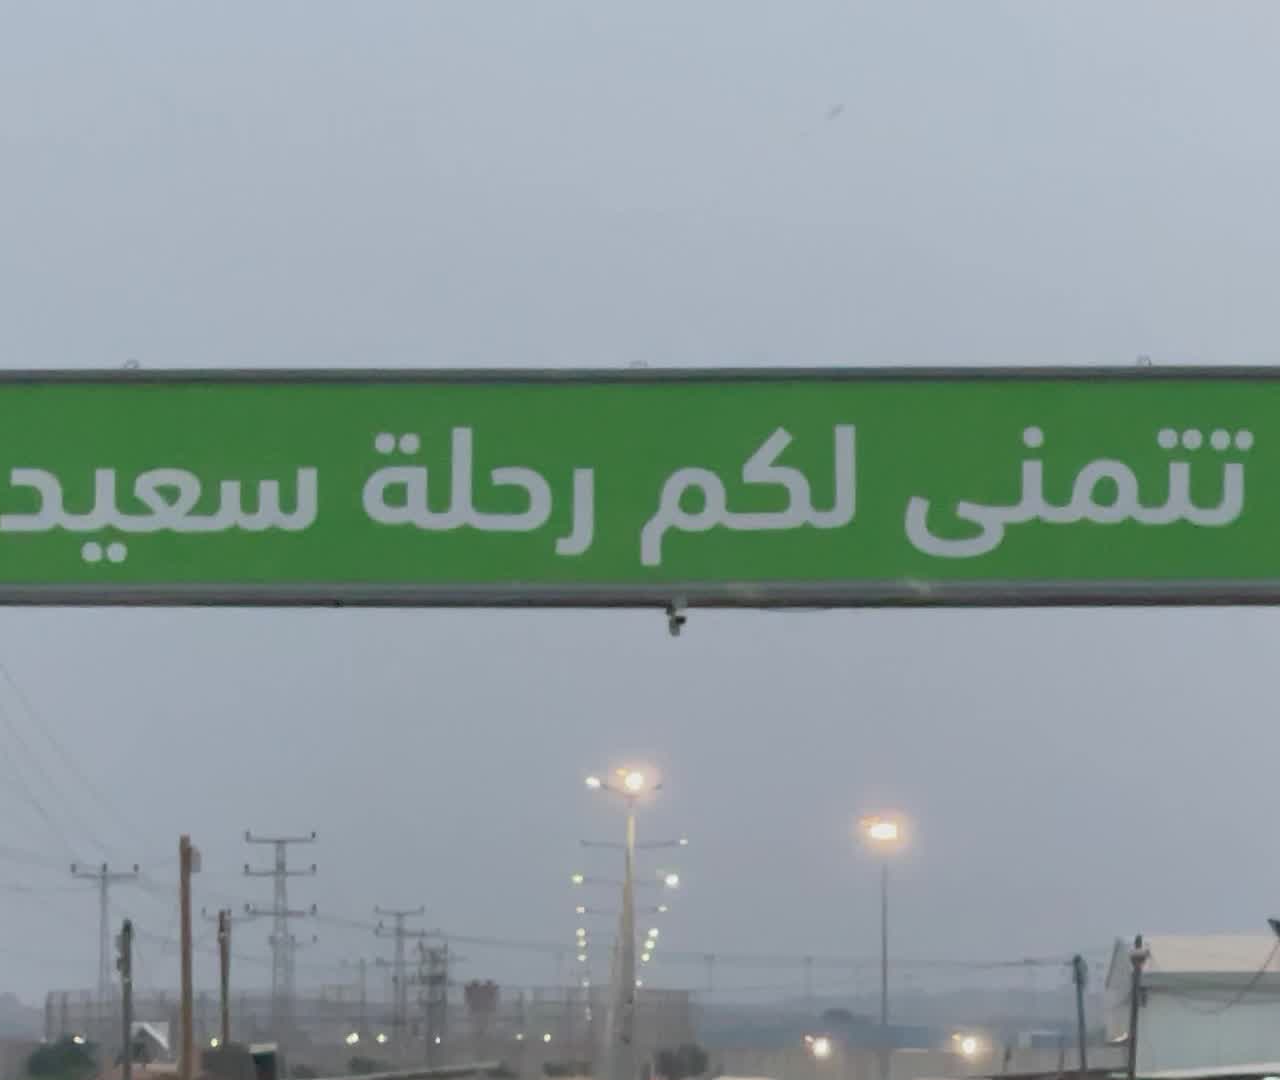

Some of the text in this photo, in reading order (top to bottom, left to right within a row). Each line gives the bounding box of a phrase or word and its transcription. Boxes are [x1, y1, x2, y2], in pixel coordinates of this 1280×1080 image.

[362, 427, 594, 555] رحلة
[641, 425, 856, 565] لكم
[905, 427, 1253, 557] تتمنى
